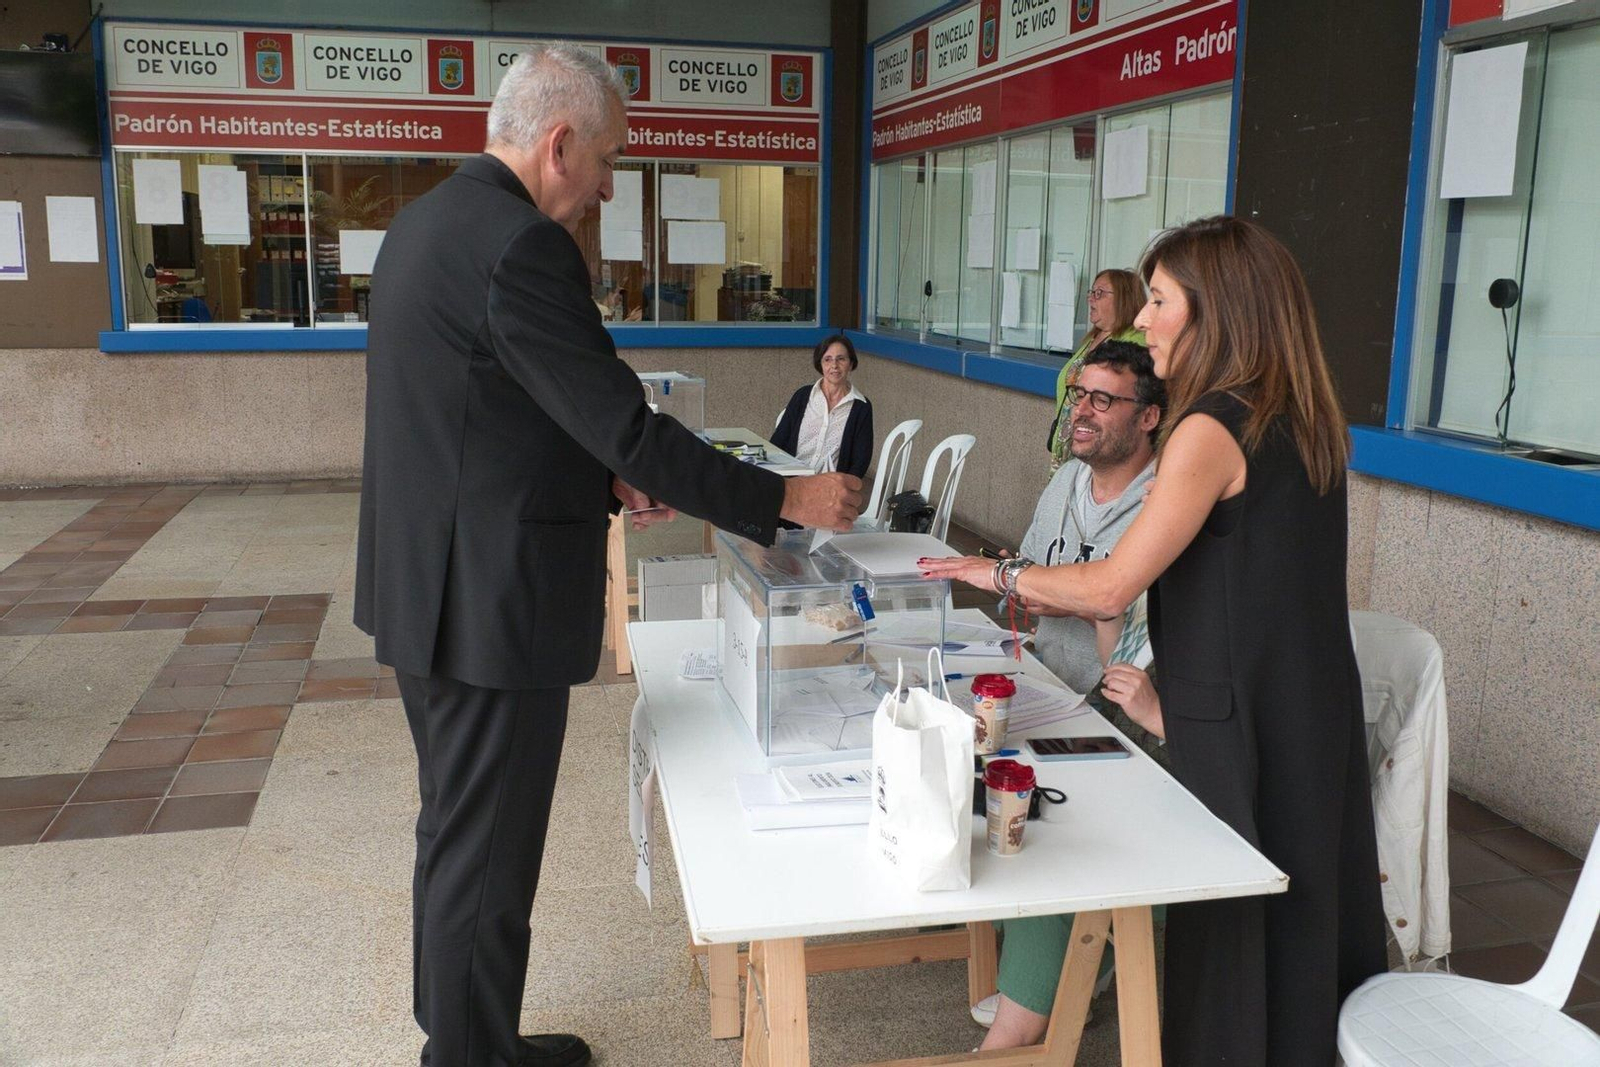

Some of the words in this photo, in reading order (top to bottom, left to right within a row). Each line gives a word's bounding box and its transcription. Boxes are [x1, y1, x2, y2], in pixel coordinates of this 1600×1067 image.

[934, 19, 974, 50] CONCELLO
[1016, 18, 1029, 39] DE
[1032, 7, 1056, 33] VIGO
[123, 38, 229, 57] CONCELLO
[313, 45, 413, 63] CONCELLO
[938, 51, 948, 69] DE
[950, 43, 968, 64] VIGO
[1120, 48, 1162, 81] Altas
[1175, 20, 1237, 66] Padrón
[137, 59, 162, 74] DE
[171, 60, 218, 76] VIGO
[668, 60, 758, 77] CONCELLO
[877, 48, 909, 74] CONCELLO
[326, 65, 350, 80] DE
[359, 66, 402, 82] VIGO
[880, 75, 888, 91] DE
[889, 69, 904, 87] VIGO
[679, 78, 701, 93] DE
[708, 79, 748, 94] VIGO
[114, 114, 193, 134] Padrón
[201, 115, 443, 139] Habitantes-Estatística
[872, 127, 894, 148] Padrón
[895, 102, 982, 142] Habitantes-Estatística
[628, 127, 817, 151] bitantes-Estatística
